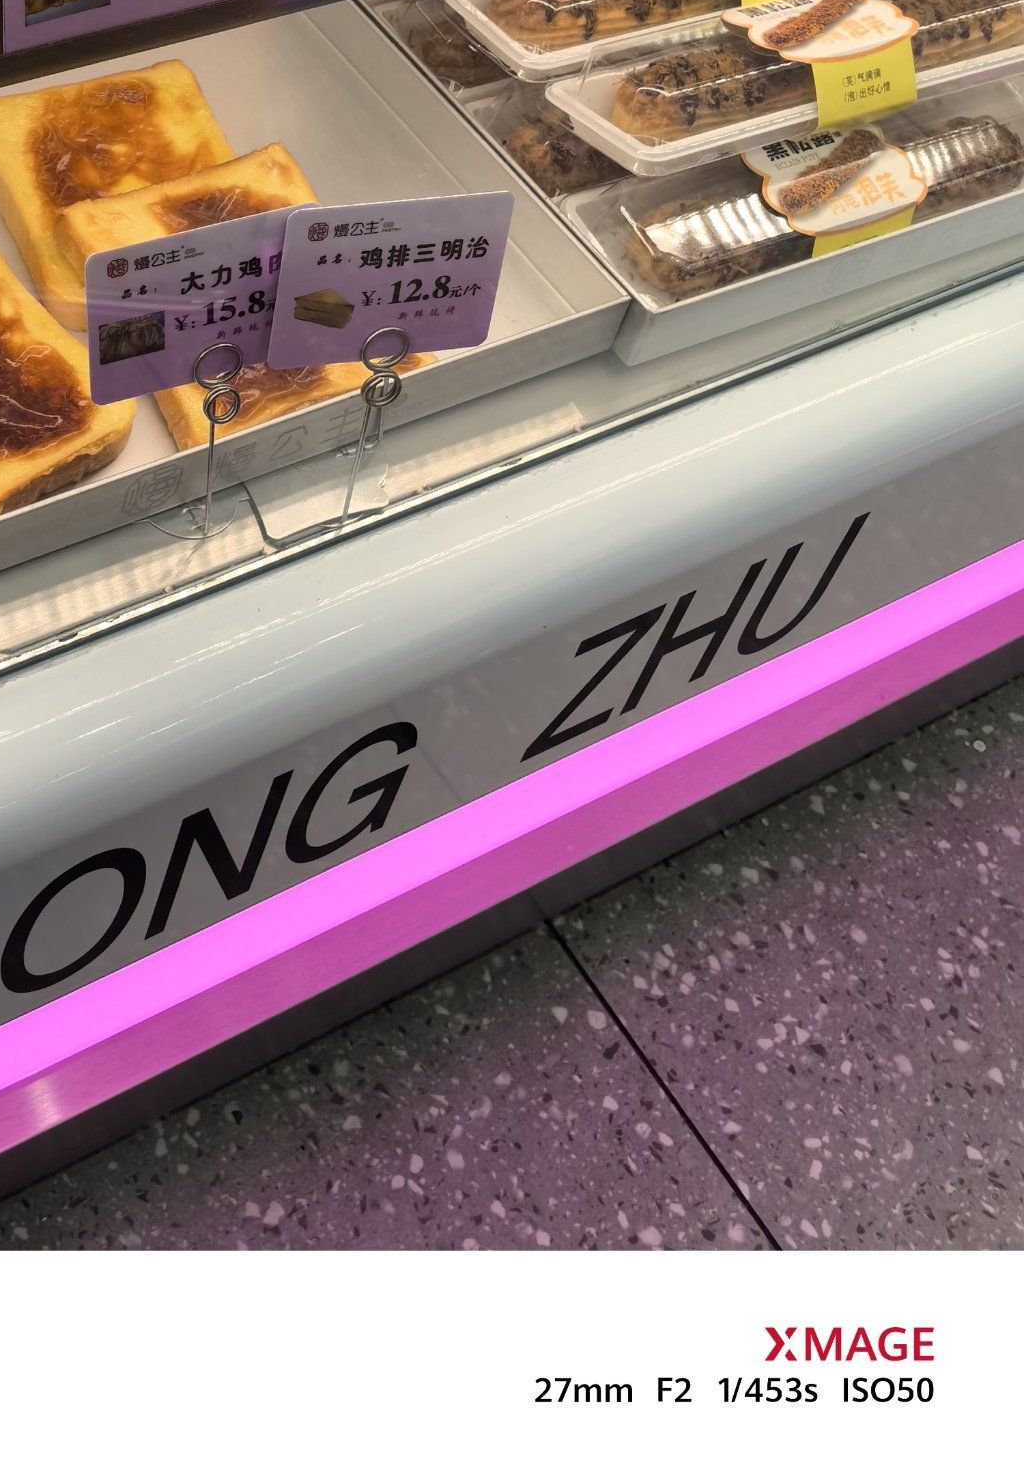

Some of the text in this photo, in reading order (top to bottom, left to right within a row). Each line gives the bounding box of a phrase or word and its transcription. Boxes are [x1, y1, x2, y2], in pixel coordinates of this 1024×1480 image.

[359, 235, 490, 269] 鸡排三明治
[520, 512, 871, 763] ZHU
